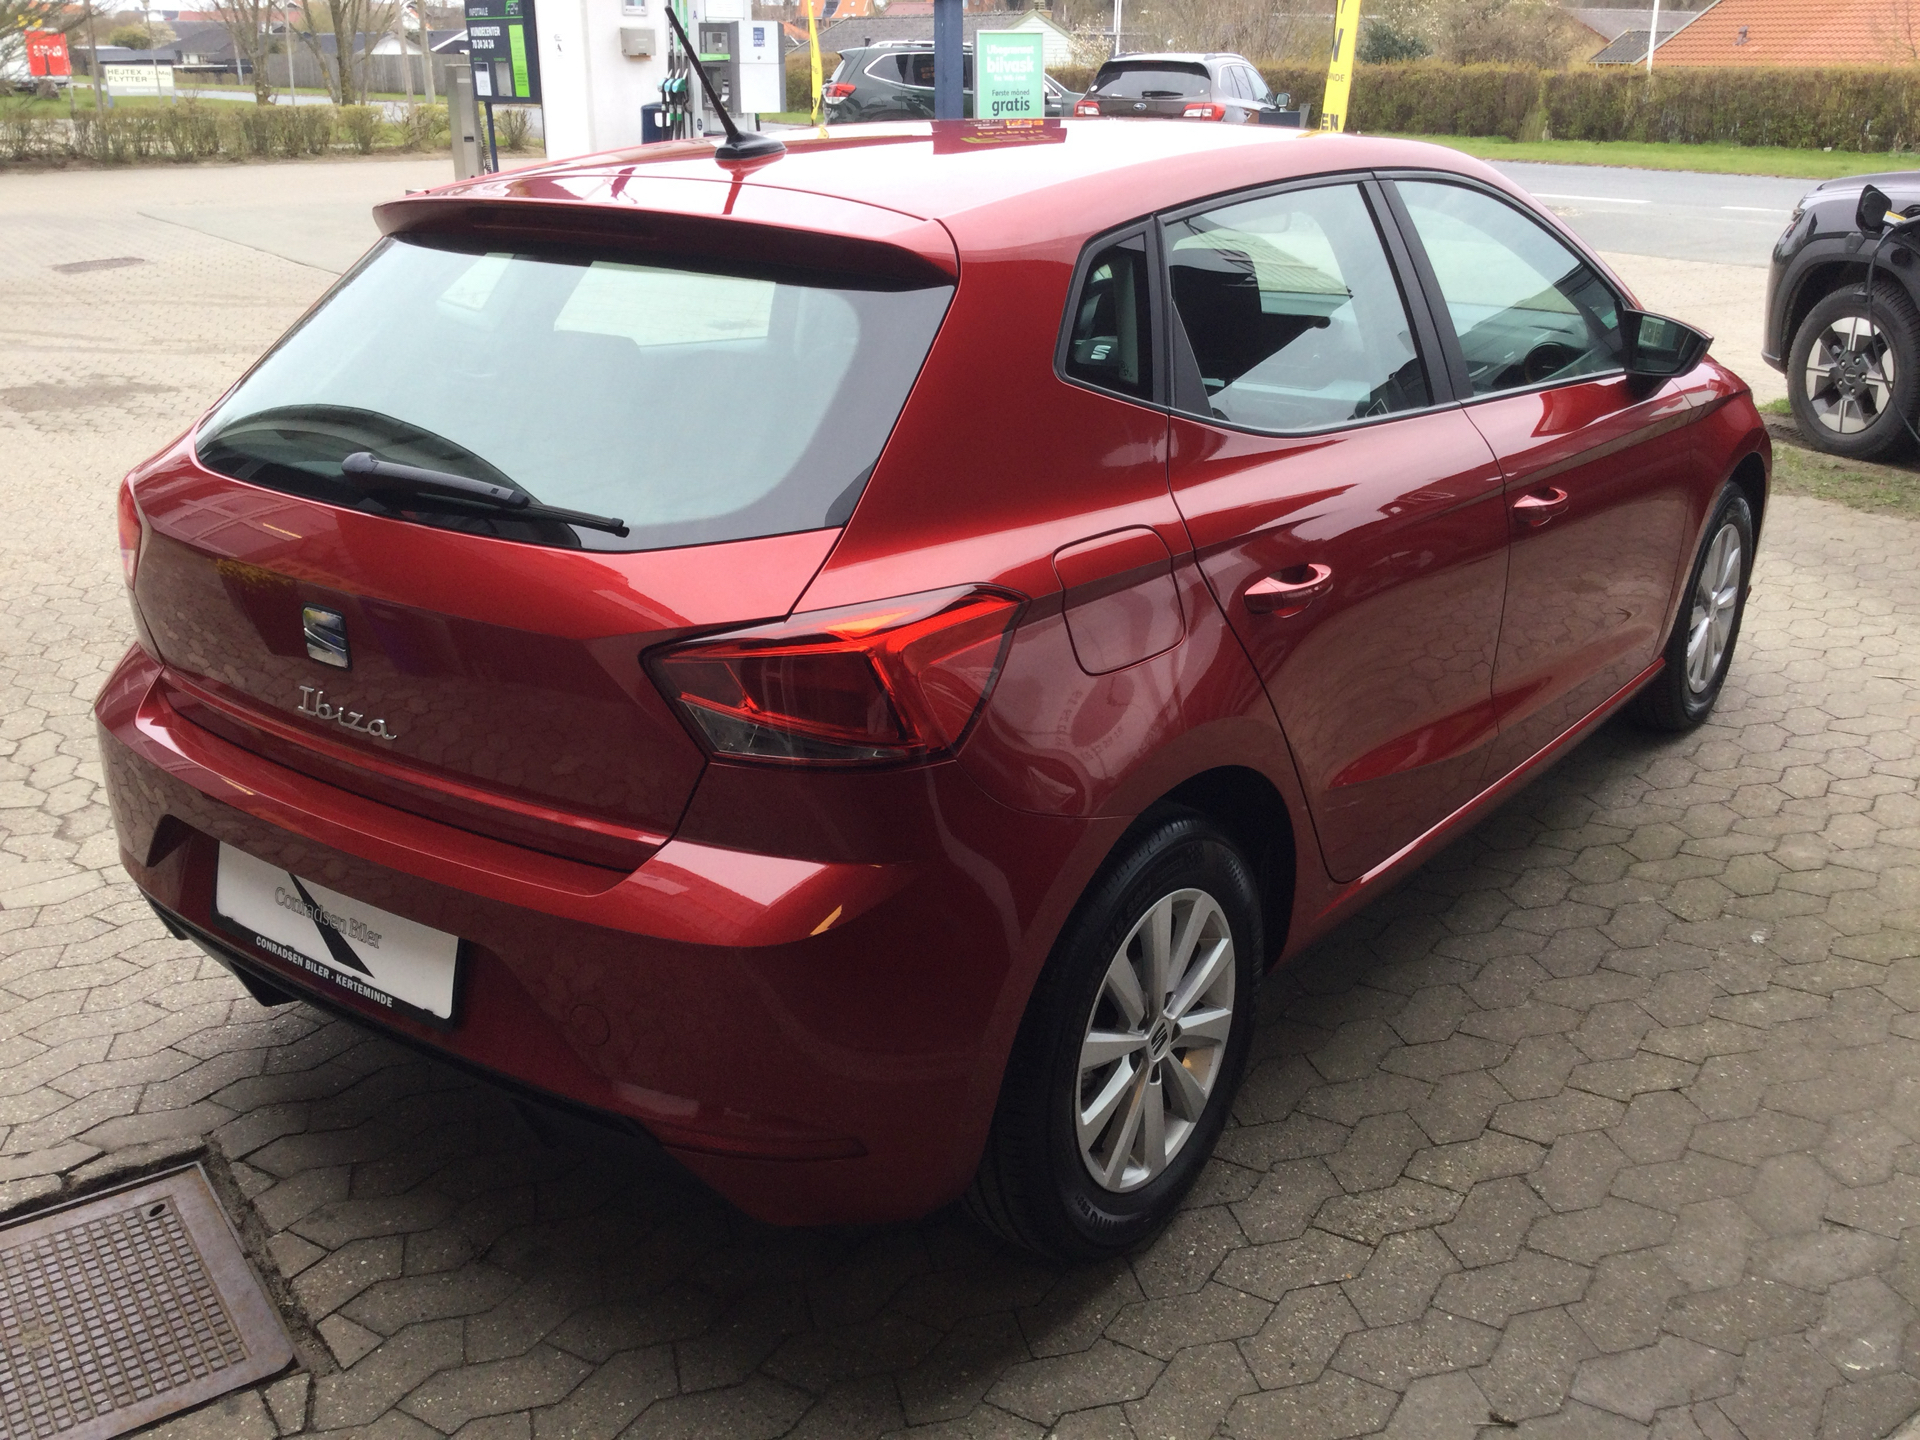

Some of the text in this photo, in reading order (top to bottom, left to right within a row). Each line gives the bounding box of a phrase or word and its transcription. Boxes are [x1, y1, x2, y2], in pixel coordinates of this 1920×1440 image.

[470, 26, 500, 36] KUNDECENTER
[986, 56, 1034, 73] bilvask
[1011, 88, 1030, 96] måned
[992, 97, 1030, 117] gratis
[297, 685, 398, 741] Ibiza
[274, 886, 382, 949] Conradsen Biler
[256, 936, 393, 1008] CONRADSEN BILER KERTEMINDE
